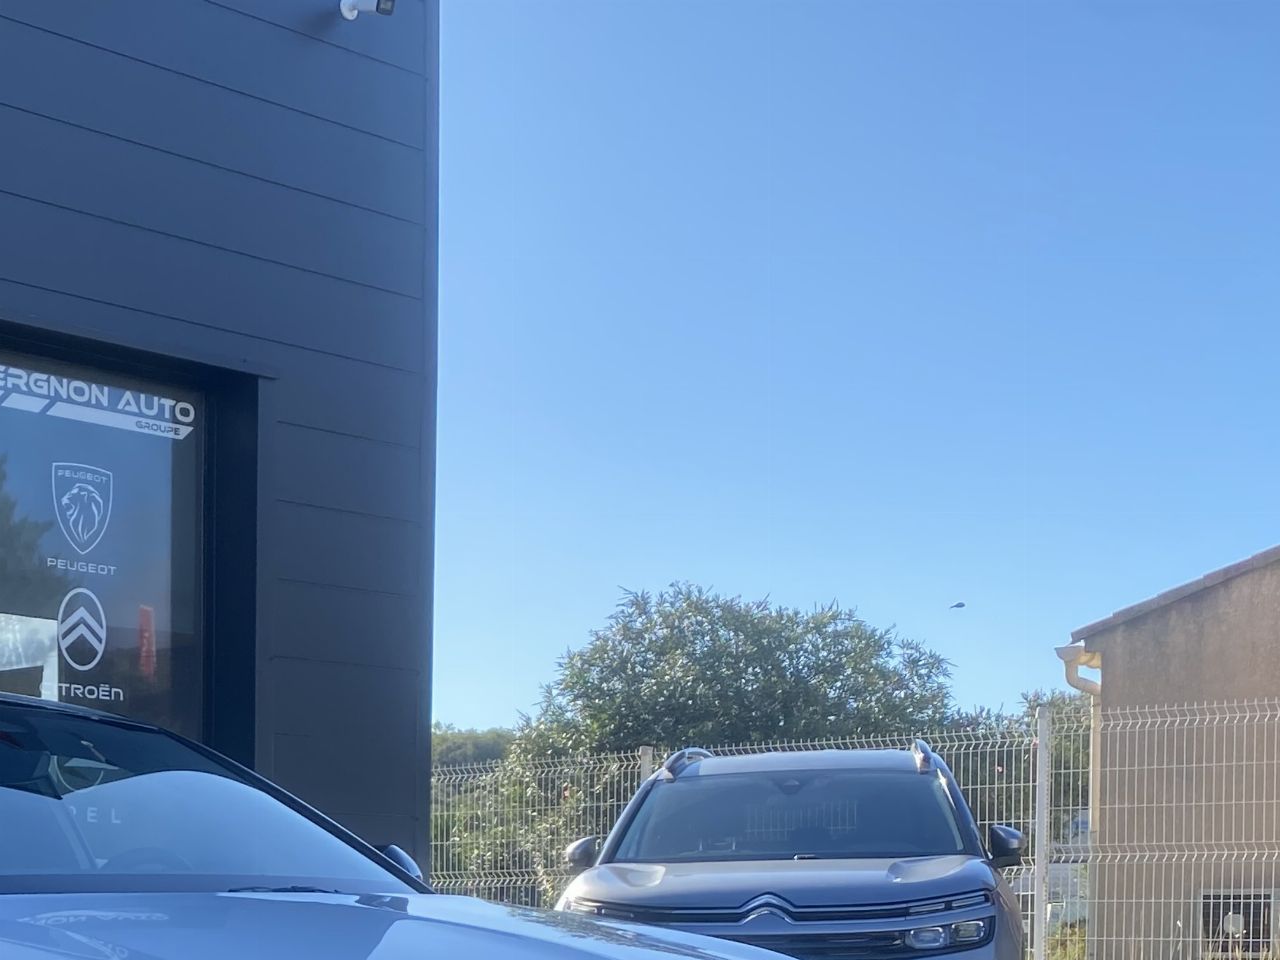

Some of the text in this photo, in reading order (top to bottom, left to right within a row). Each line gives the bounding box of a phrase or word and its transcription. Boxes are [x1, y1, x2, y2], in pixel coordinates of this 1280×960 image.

[116, 389, 196, 424] AUTO
[135, 420, 181, 436] GROUPE
[57, 469, 108, 484] PEUGEOT
[47, 557, 117, 576] PEUGEOT
